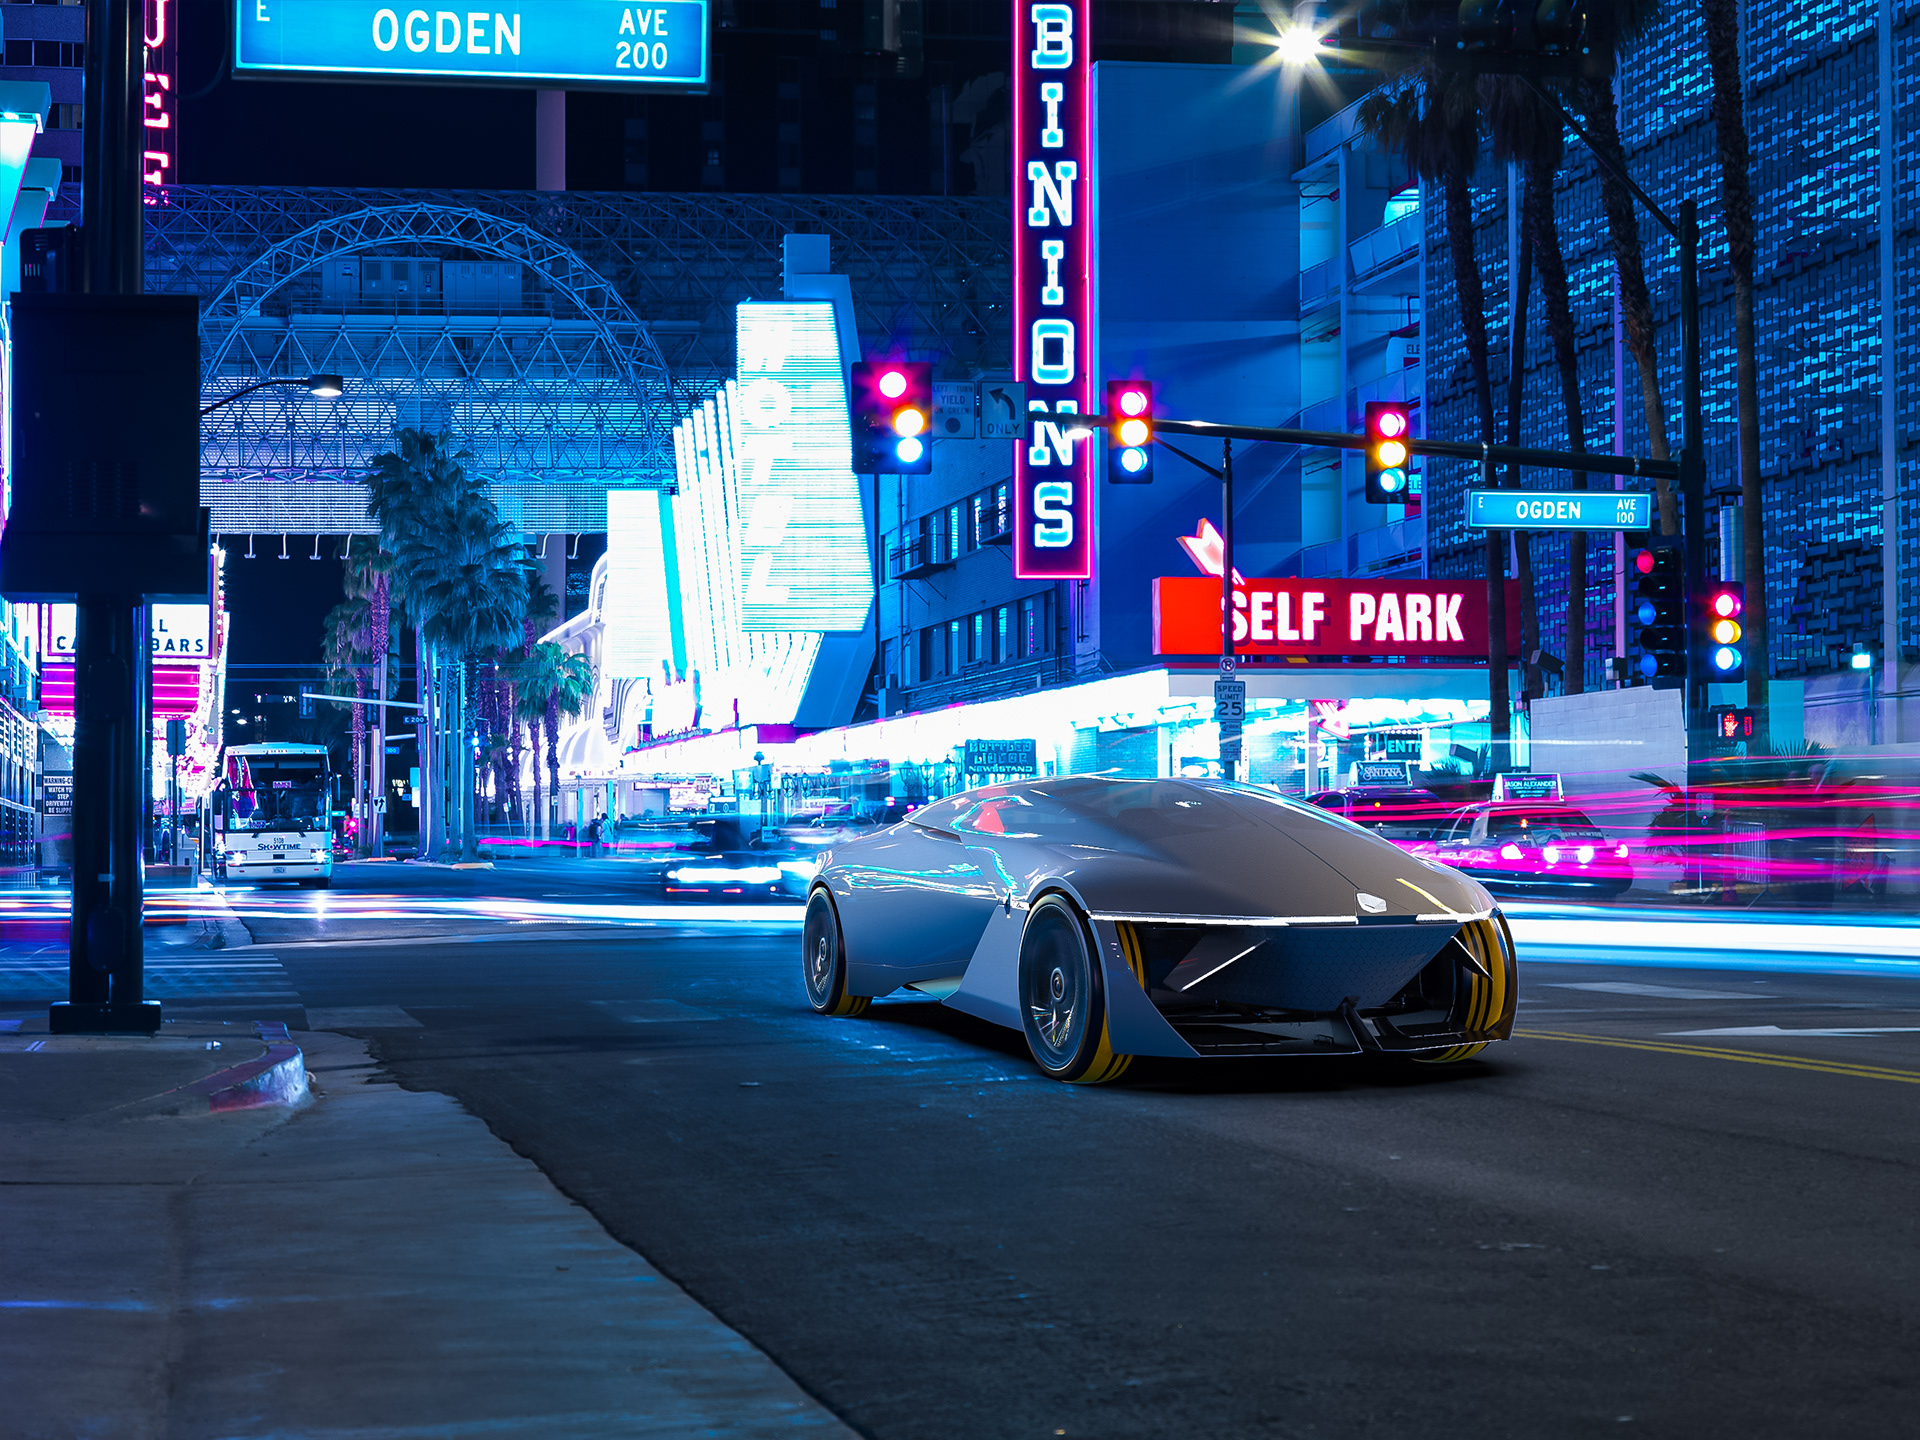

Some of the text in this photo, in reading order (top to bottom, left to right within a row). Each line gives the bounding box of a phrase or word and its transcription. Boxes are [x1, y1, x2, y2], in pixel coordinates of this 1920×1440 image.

[256, 0, 668, 55] E OGDEN AVE
[615, 42, 668, 69] 200
[1028, 3, 1078, 548] BINIONS
[933, 384, 973, 393] LEFT TURN
[941, 395, 965, 405] YIELD
[934, 406, 969, 414] ON GREEN
[987, 423, 1020, 435] ONLY
[1478, 497, 1637, 519] E OGDEN AVE
[1616, 512, 1635, 523] 100
[1221, 590, 1465, 642] SELF PARK
[152, 638, 204, 653] BARS
[1217, 685, 1243, 693] SPEED
[1218, 701, 1242, 716] 25
[969, 740, 1032, 753] BOTTLED
[974, 752, 1029, 765] LIQUOR
[1363, 765, 1406, 780] SANTANA
[1504, 780, 1557, 788] JASON ALEXANDER
